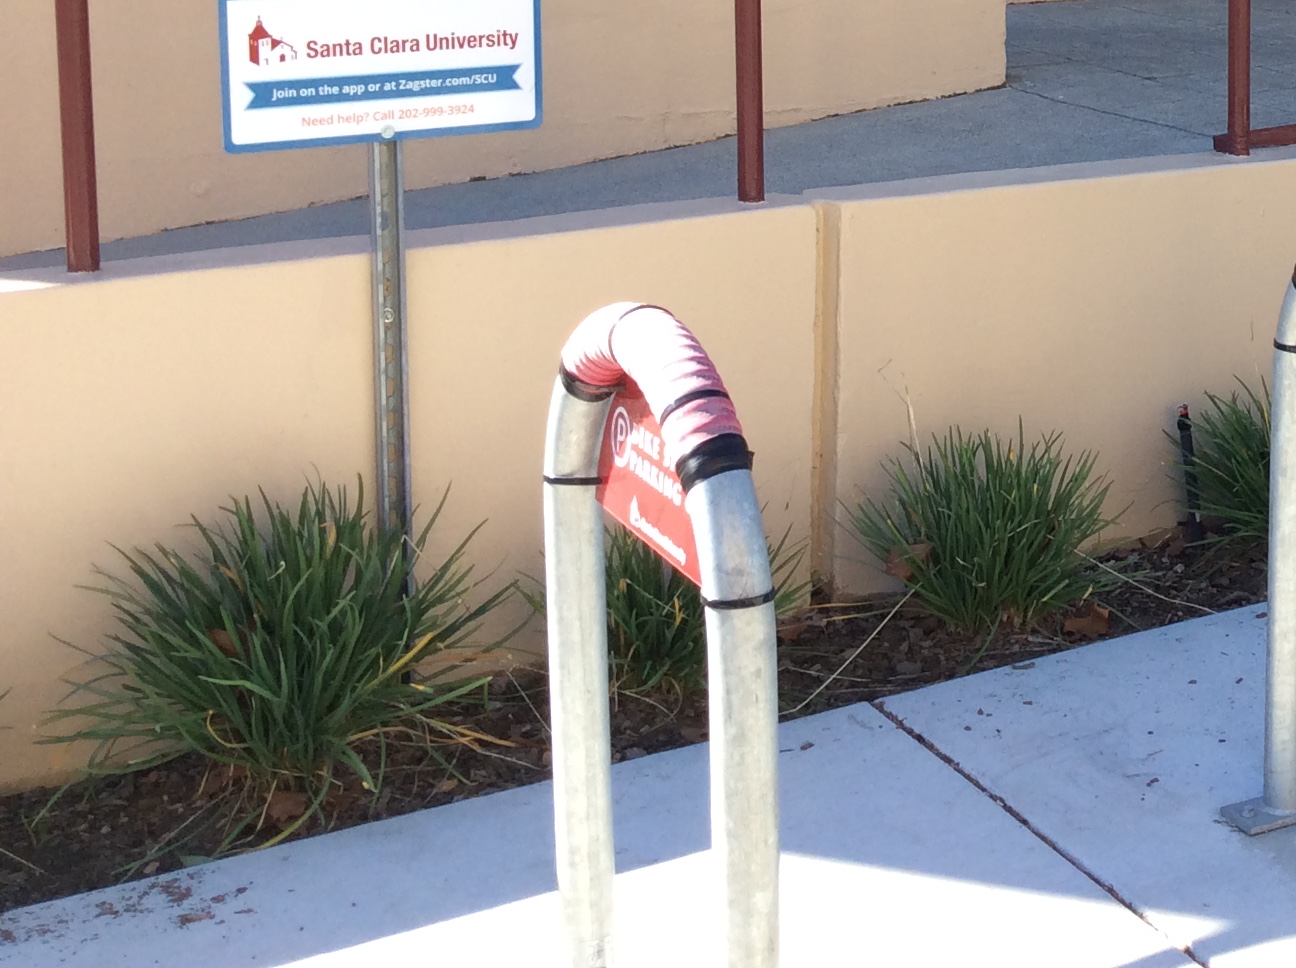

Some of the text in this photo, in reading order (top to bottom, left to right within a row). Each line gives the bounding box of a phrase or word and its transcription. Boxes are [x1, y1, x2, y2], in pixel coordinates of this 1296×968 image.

[306, 29, 519, 59] Santa Clara University
[271, 73, 497, 102] Join on the app or at Zagster.com/SCU
[301, 104, 475, 127] Need help? Call 202-999-3924
[631, 422, 660, 461] BIKE
[629, 450, 682, 507] PARKING
